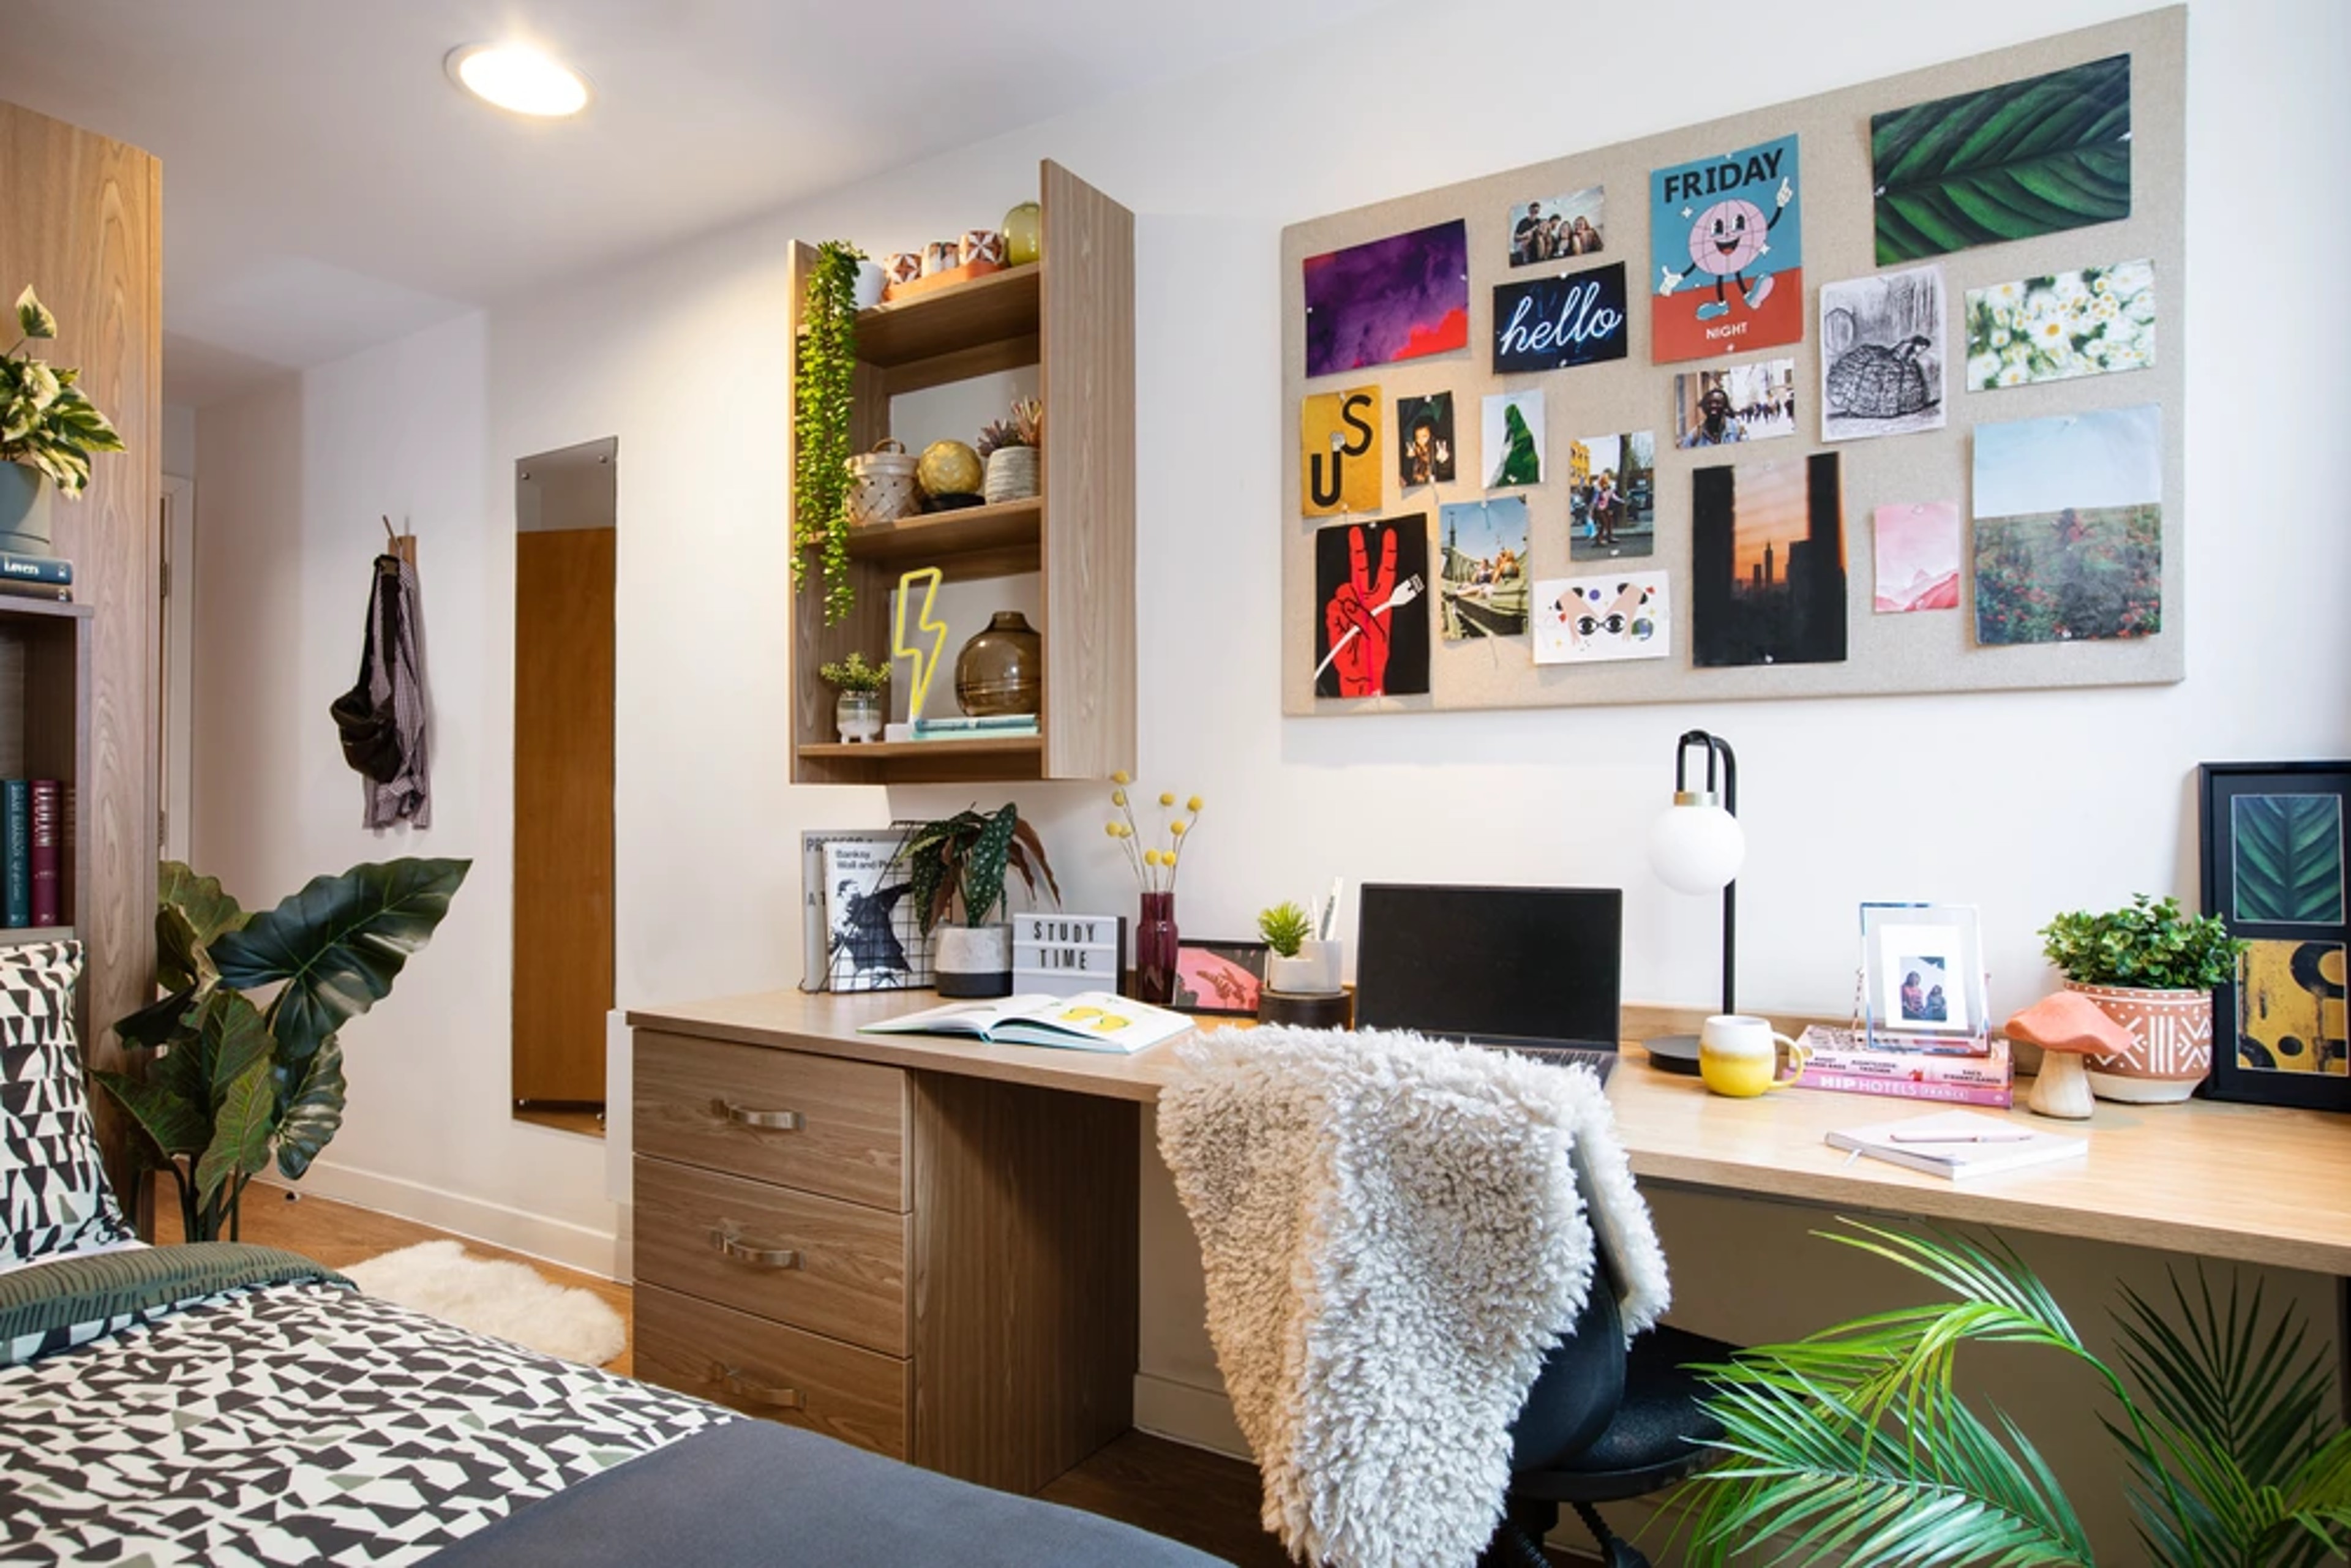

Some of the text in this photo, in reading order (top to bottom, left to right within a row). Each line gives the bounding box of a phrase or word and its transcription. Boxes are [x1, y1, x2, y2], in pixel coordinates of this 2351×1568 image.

[1664, 148, 1784, 203] FRIDAY
[1500, 281, 1622, 356] hello
[1706, 321, 1748, 340] NIGHT
[836, 849, 870, 860] Banksy
[858, 861, 876, 869] and
[1034, 921, 1095, 943] STUDY
[1040, 949, 1087, 969] TIME
[1820, 1076, 1856, 1090] HIP
[1859, 1080, 1916, 1097] HOTELS
